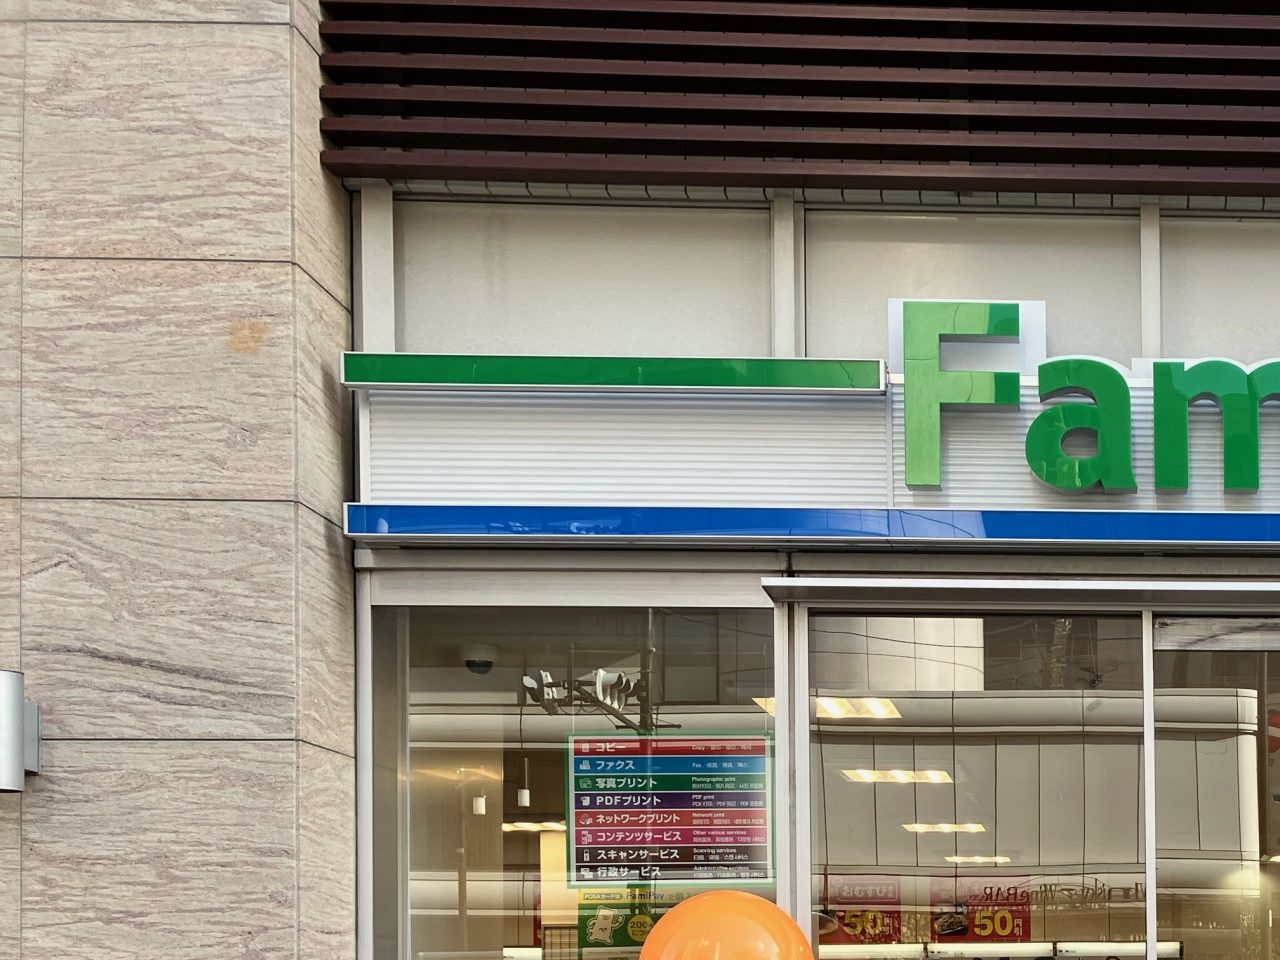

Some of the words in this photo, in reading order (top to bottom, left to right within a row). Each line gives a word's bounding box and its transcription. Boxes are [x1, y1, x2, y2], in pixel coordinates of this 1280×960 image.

[596, 760, 635, 770] ファクス
[596, 778, 657, 788] 写真プリント
[596, 796, 661, 806] PDFプリント
[596, 813, 680, 823] ネットワークプリント
[597, 831, 682, 842] コンテンツサービス
[597, 849, 680, 860] スキャンサービス
[597, 866, 661, 877] 行政サービス
[843, 910, 882, 935] 50
[974, 909, 1013, 936] 50
